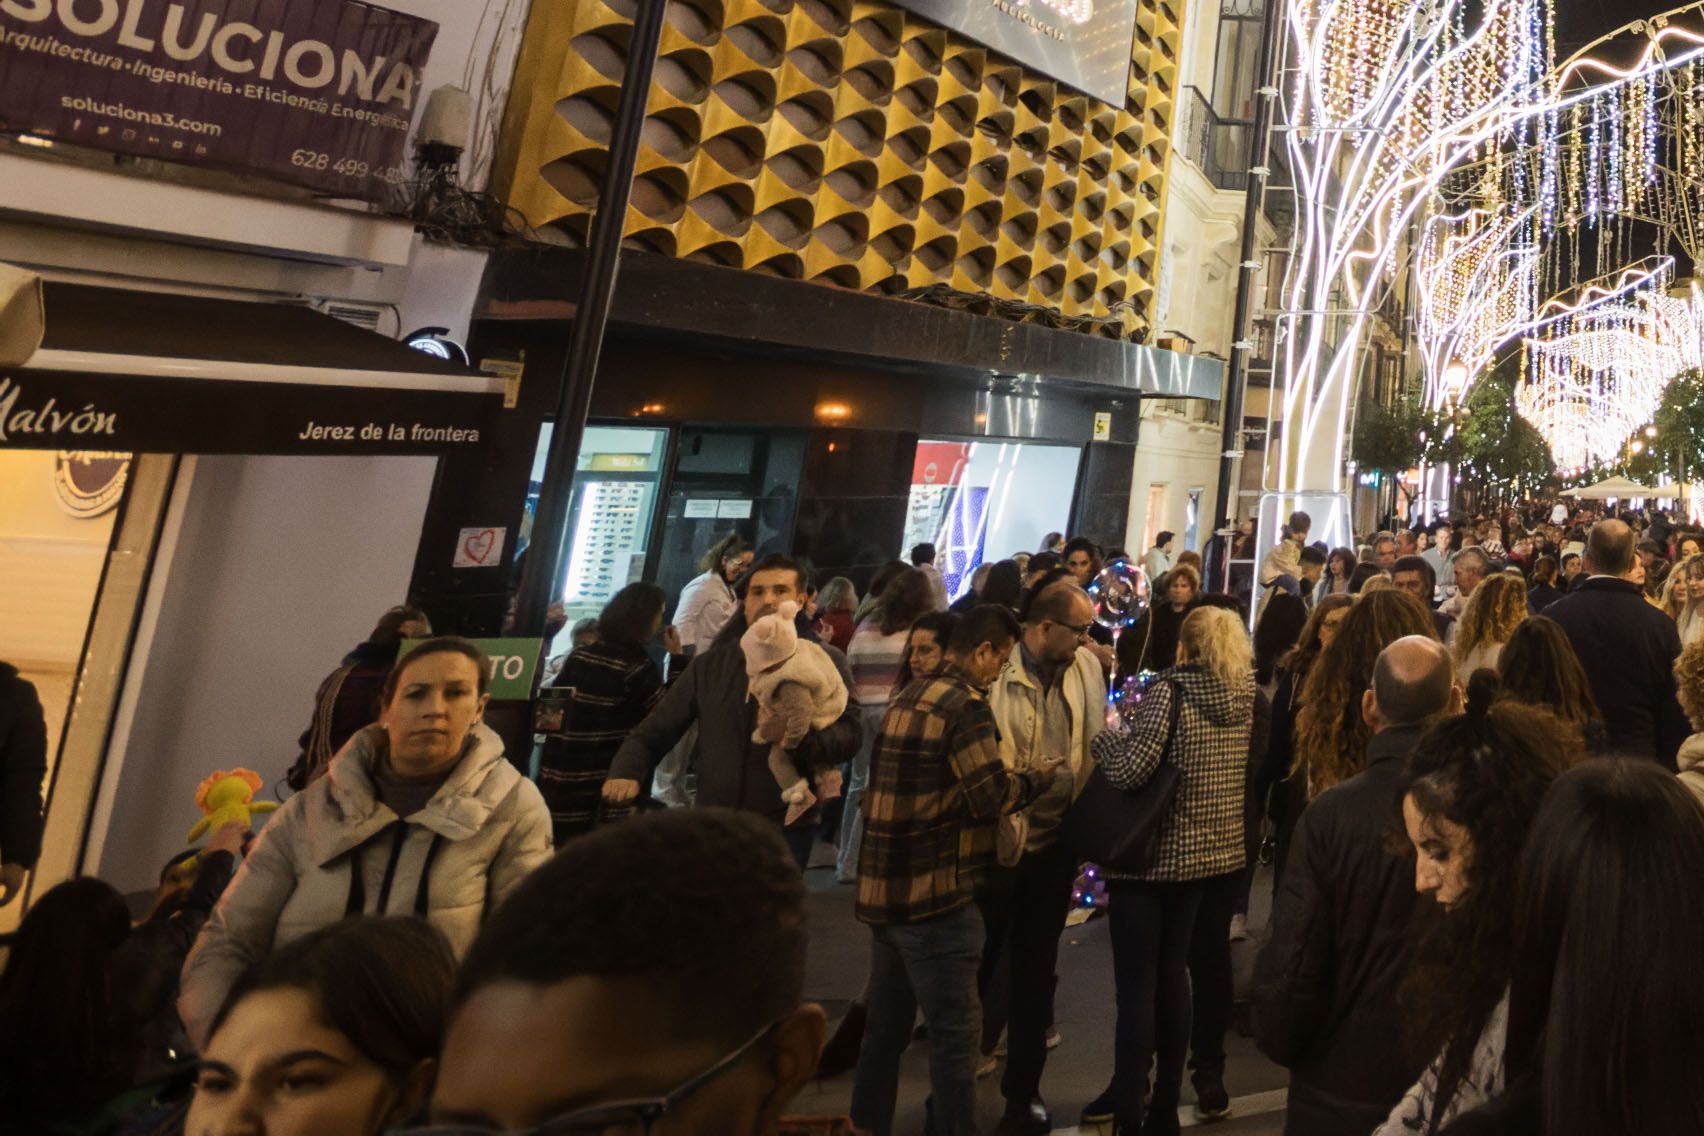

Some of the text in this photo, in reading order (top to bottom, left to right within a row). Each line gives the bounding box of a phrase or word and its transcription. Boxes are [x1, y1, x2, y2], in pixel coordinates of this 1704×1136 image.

[61, 95, 222, 137] soluciona3.com
[291, 149, 328, 172] 628
[299, 422, 480, 442] Jerez de la frontera
